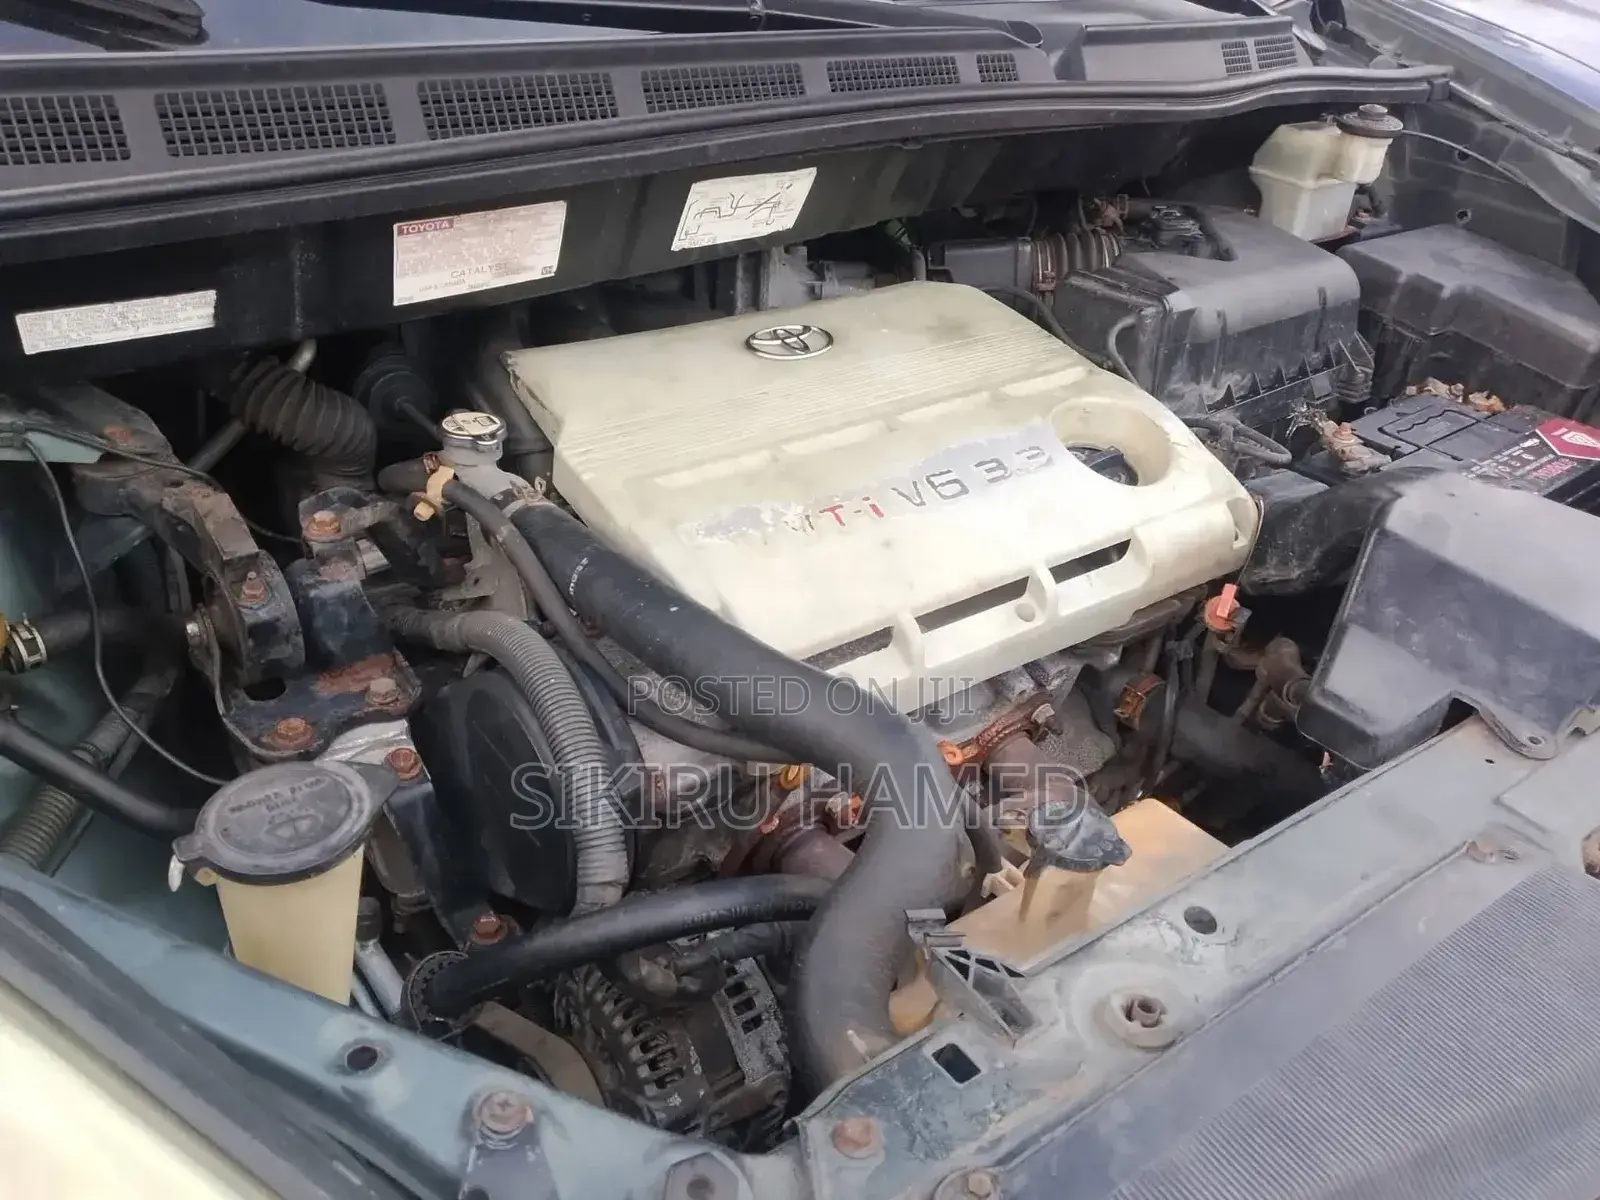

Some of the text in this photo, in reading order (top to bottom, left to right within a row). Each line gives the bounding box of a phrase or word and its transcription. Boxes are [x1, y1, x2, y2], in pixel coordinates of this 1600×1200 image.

[401, 220, 450, 234] TOYOTA
[450, 262, 507, 278] CATALYST
[891, 469, 970, 507] V6
